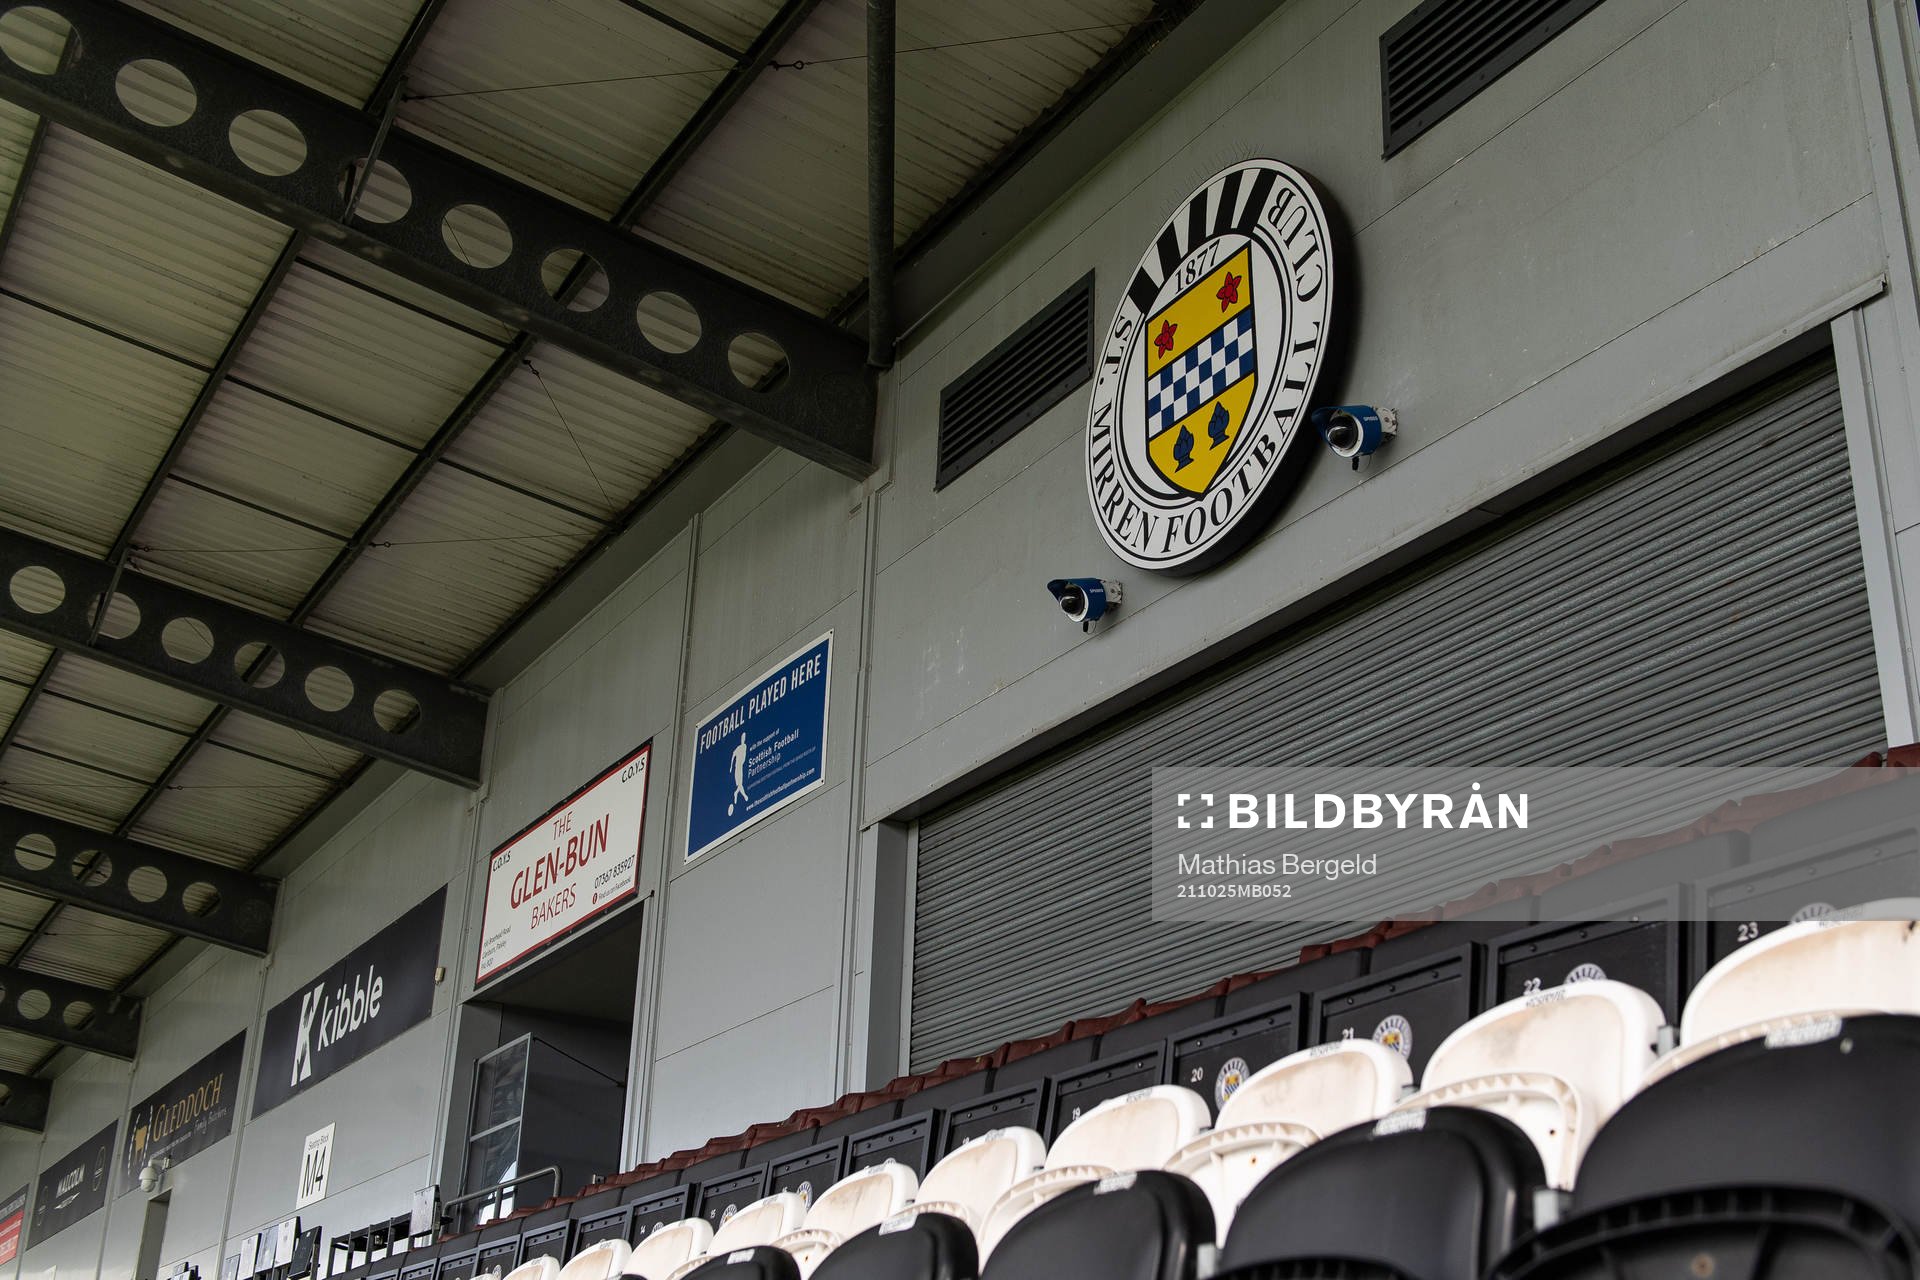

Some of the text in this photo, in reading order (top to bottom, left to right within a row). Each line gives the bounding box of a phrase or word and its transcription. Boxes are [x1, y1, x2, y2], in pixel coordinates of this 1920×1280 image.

[1174, 240, 1221, 294] 1877
[1088, 409, 1159, 552] MIRREN
[1161, 321, 1320, 553] FOOTBALL
[1268, 187, 1322, 302] CLUB
[700, 653, 822, 754] FOOTBALL PLAYED HERE
[748, 752, 781, 779] Partnership
[749, 746, 772, 768] Scottish
[774, 728, 799, 752] Football
[621, 757, 645, 783] C.O.Y.S
[553, 811, 573, 840] THE
[510, 814, 610, 909] GLEN-BUN
[531, 882, 577, 929] BAKERS
[1737, 921, 1759, 942] 23
[318, 964, 383, 1051] kibble
[1523, 977, 1541, 996] 22
[1191, 1067, 1203, 1083] 20
[301, 1146, 326, 1199] M4
